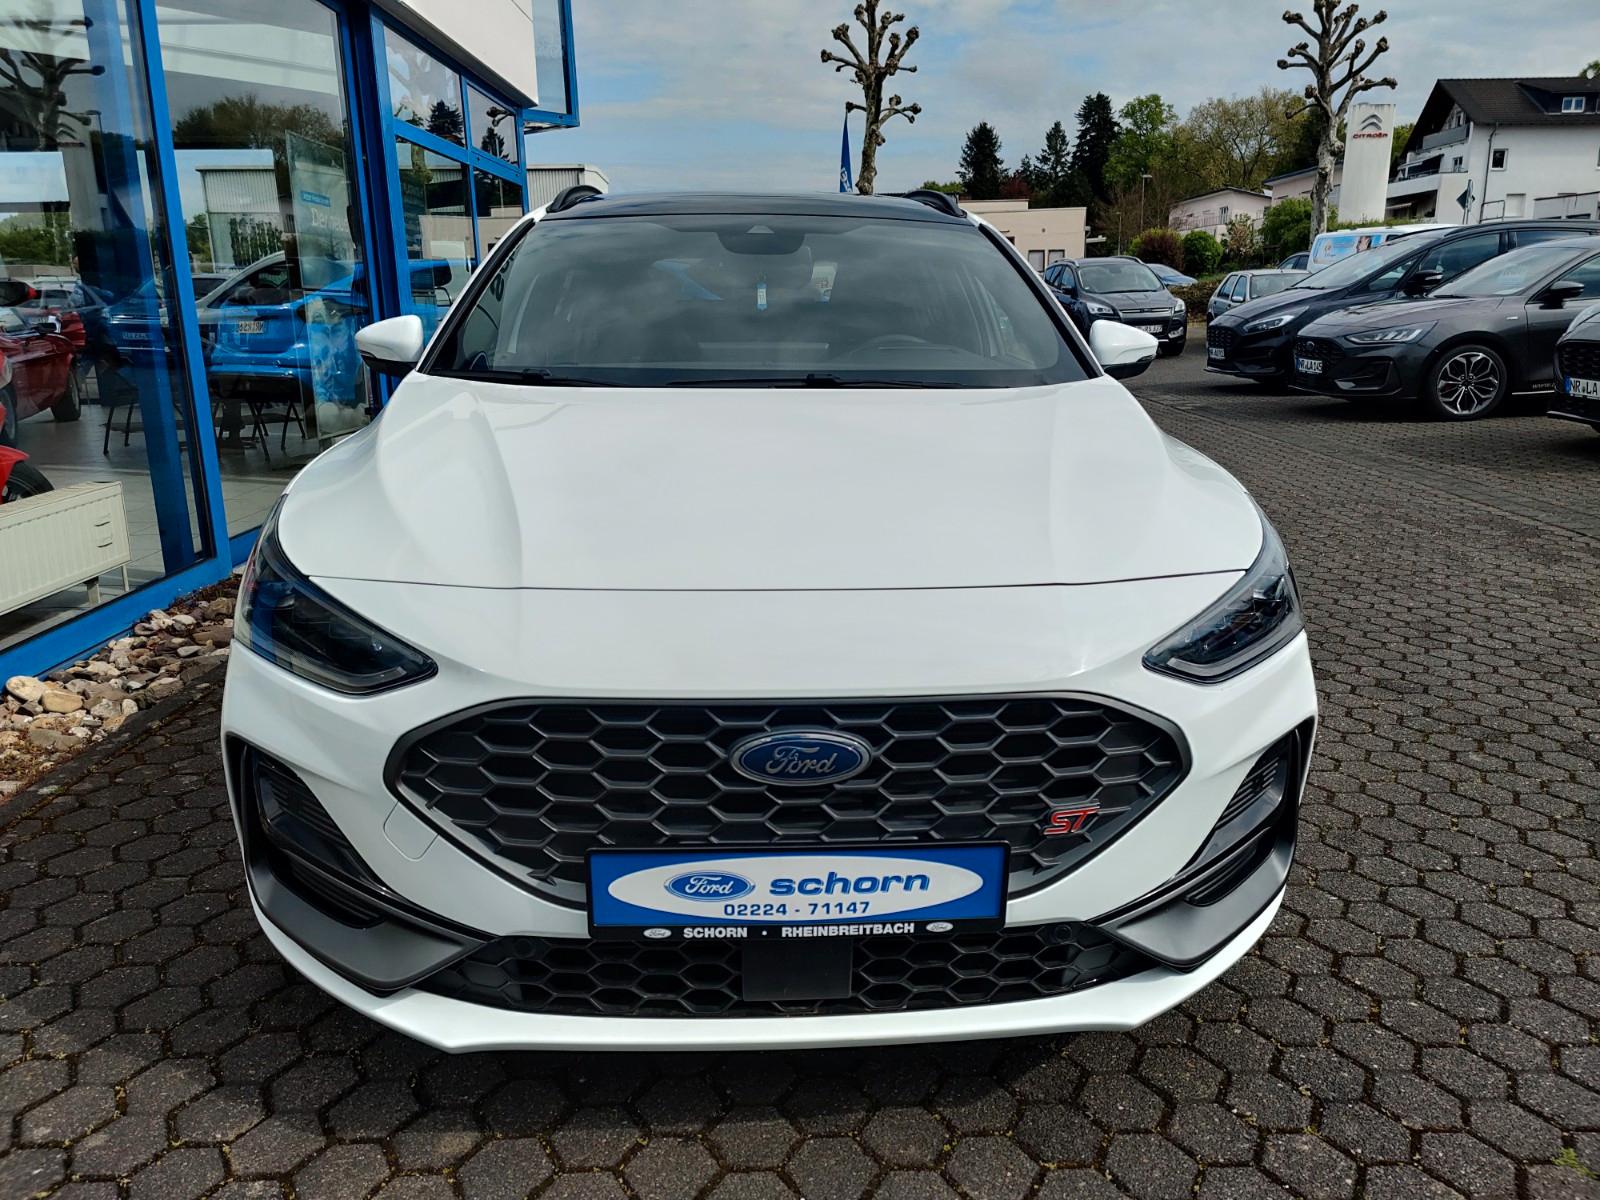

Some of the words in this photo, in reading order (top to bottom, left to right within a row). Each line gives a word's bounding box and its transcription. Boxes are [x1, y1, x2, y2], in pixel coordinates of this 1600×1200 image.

[1570, 379, 1580, 393] NR
[765, 746, 838, 774] Ford
[1044, 806, 1099, 835] ST
[685, 876, 734, 894] Ford
[769, 872, 929, 896] schorn
[724, 904, 787, 916] 02224
[808, 902, 869, 915] 71147
[683, 927, 747, 938] SCHORN
[782, 923, 914, 937] RHEINBREITBACH
